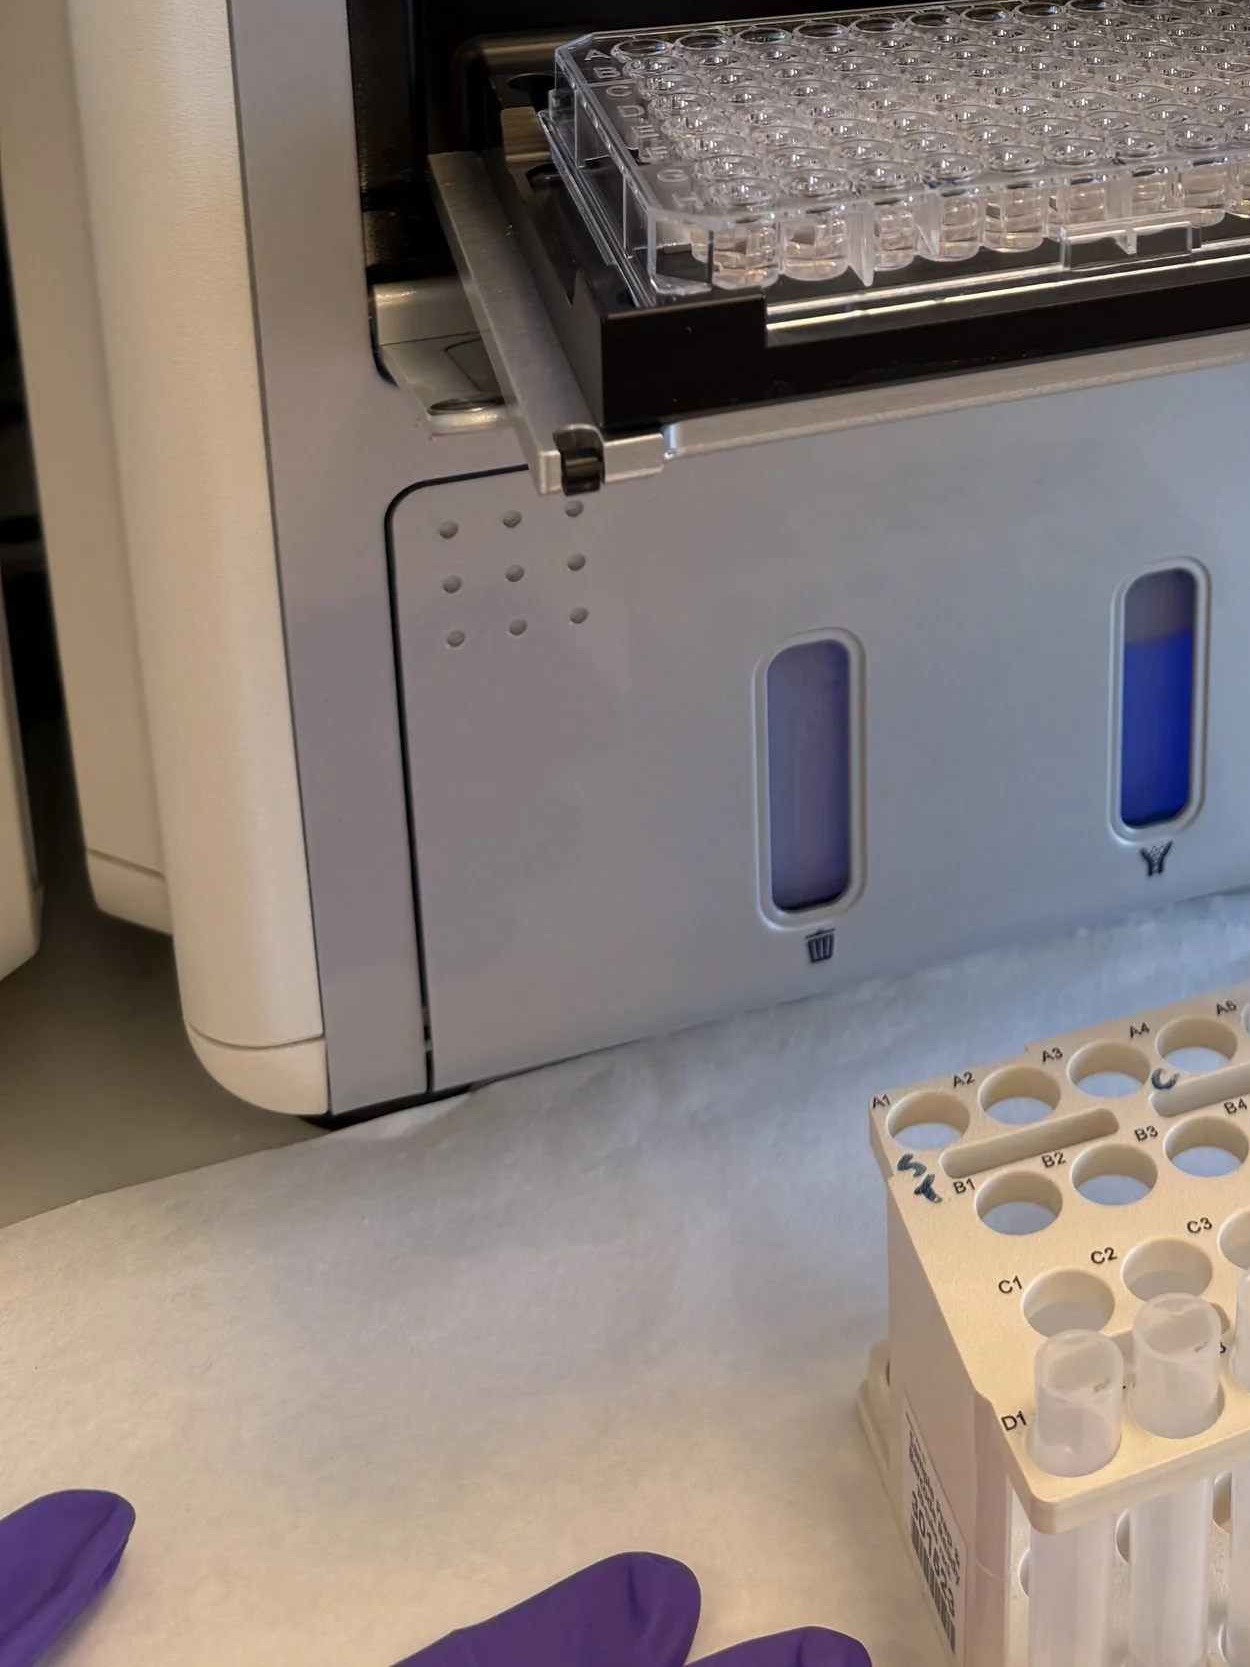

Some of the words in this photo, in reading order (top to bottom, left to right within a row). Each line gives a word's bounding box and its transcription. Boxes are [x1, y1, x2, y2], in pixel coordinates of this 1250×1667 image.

[584, 48, 611, 61] A
[593, 66, 621, 79] B
[606, 85, 632, 97] C
[617, 105, 645, 118] D
[872, 1093, 891, 1109] A1
[952, 1071, 975, 1088] A2
[1042, 1047, 1063, 1063] A3
[1128, 1022, 1150, 1039] A4
[953, 1178, 975, 1194] B1
[1041, 1151, 1067, 1168] B2
[1134, 1125, 1158, 1142] B3
[1223, 1098, 1248, 1114] B4
[998, 1276, 1022, 1295] C1
[1090, 1247, 1117, 1265] C2
[1187, 1217, 1212, 1234] C3
[1001, 1410, 1028, 1431] D1
